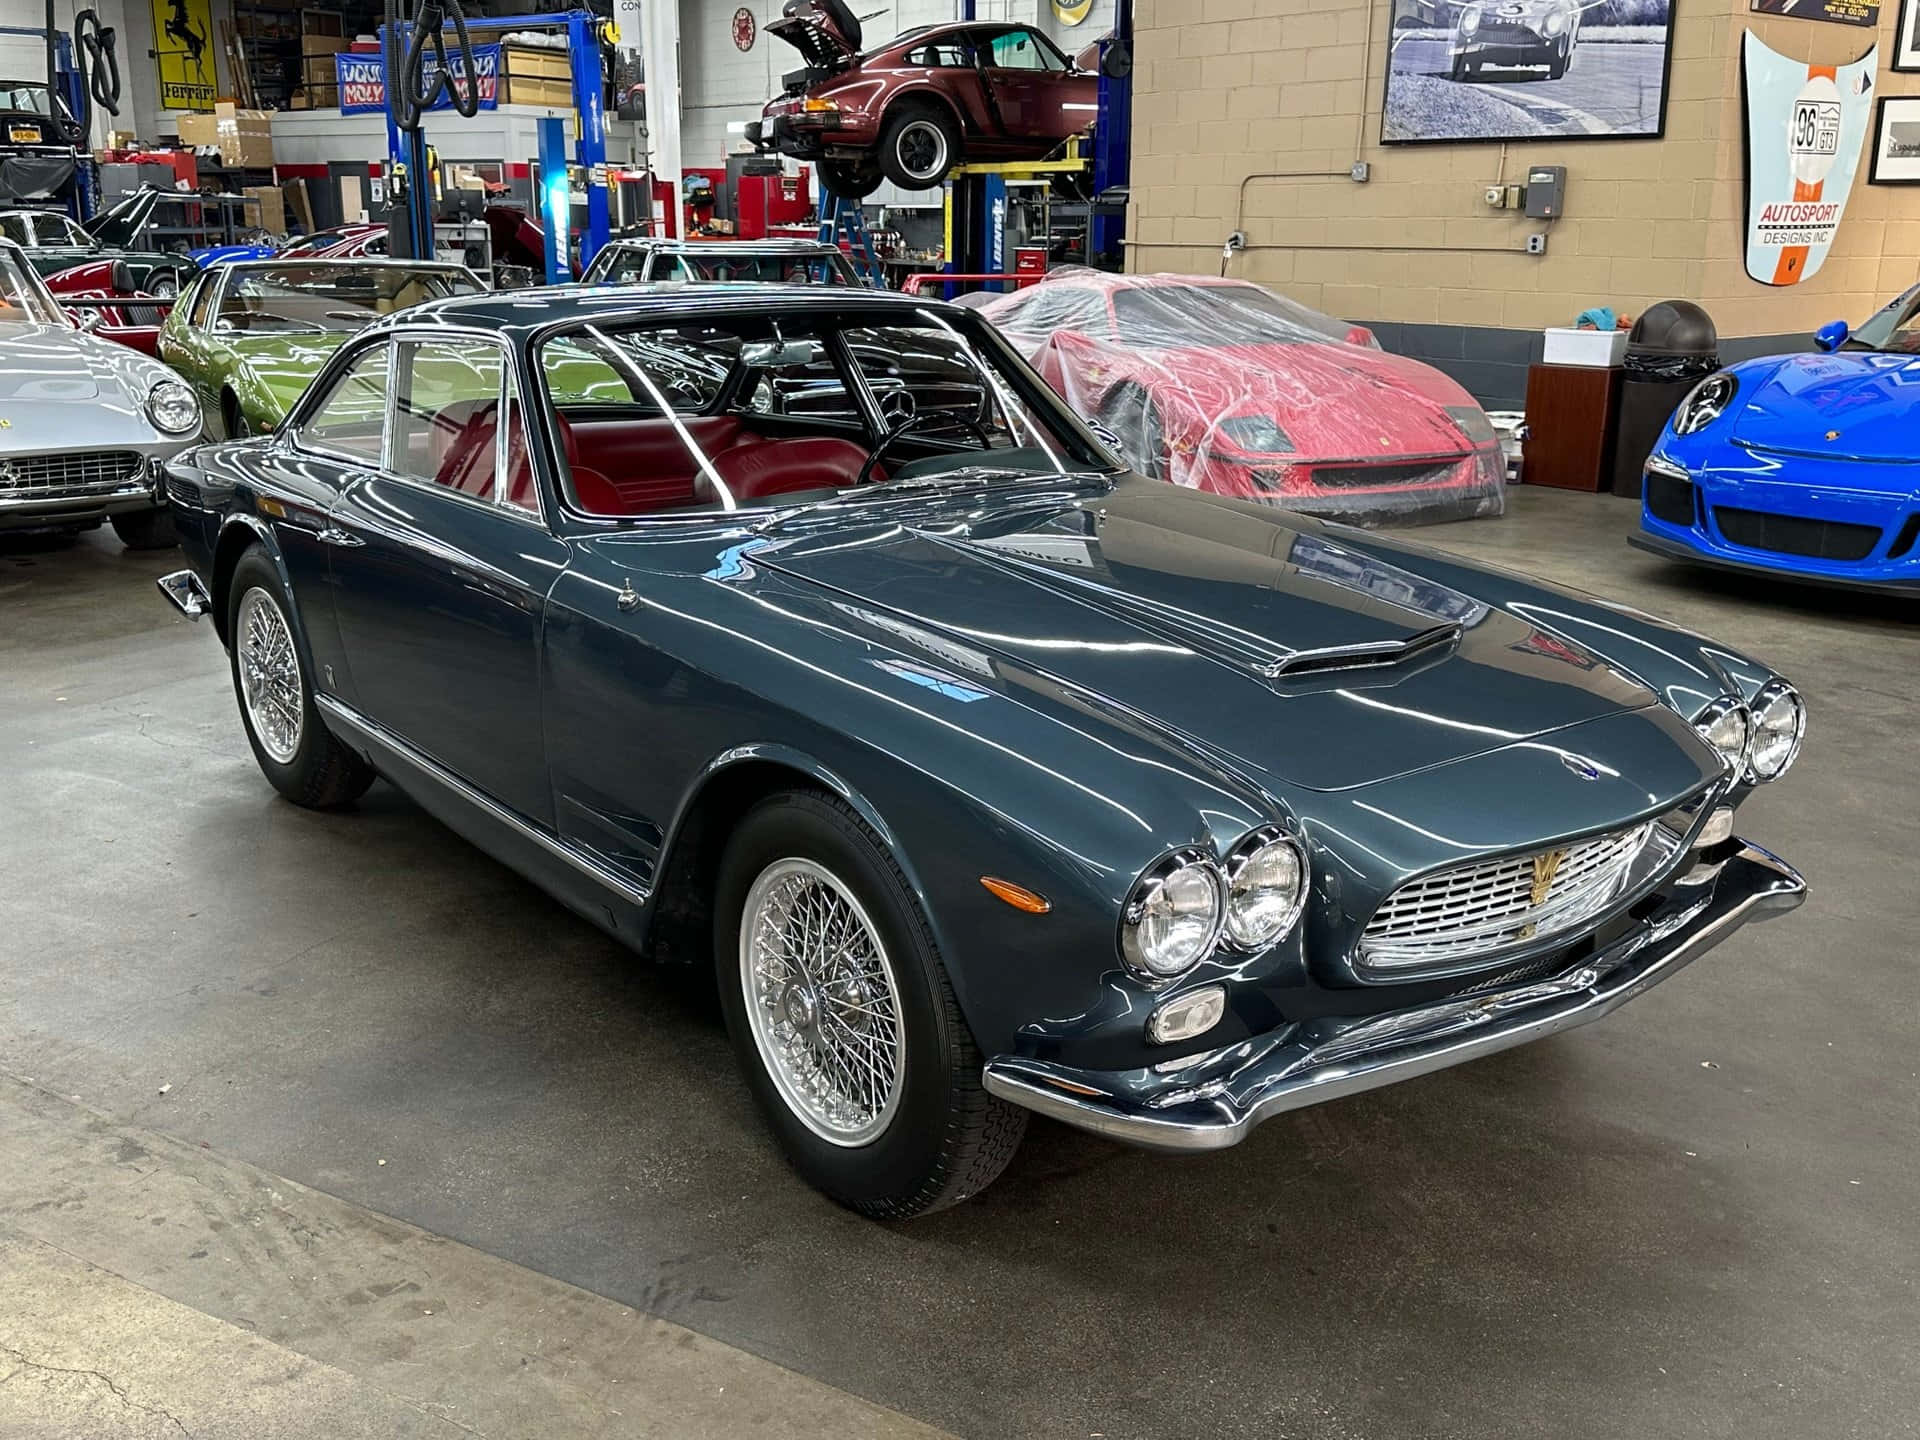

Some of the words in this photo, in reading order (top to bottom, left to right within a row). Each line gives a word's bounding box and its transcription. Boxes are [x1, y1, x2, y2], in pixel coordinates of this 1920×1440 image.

[164, 82, 215, 100] Ferrari
[344, 83, 384, 102] MOLY
[1796, 107, 1816, 146] 96
[1820, 131, 1834, 149] GT3
[1760, 204, 1839, 222] AUTOSPORT
[1763, 231, 1812, 244] DESIGNS
[1813, 231, 1829, 243] INC
